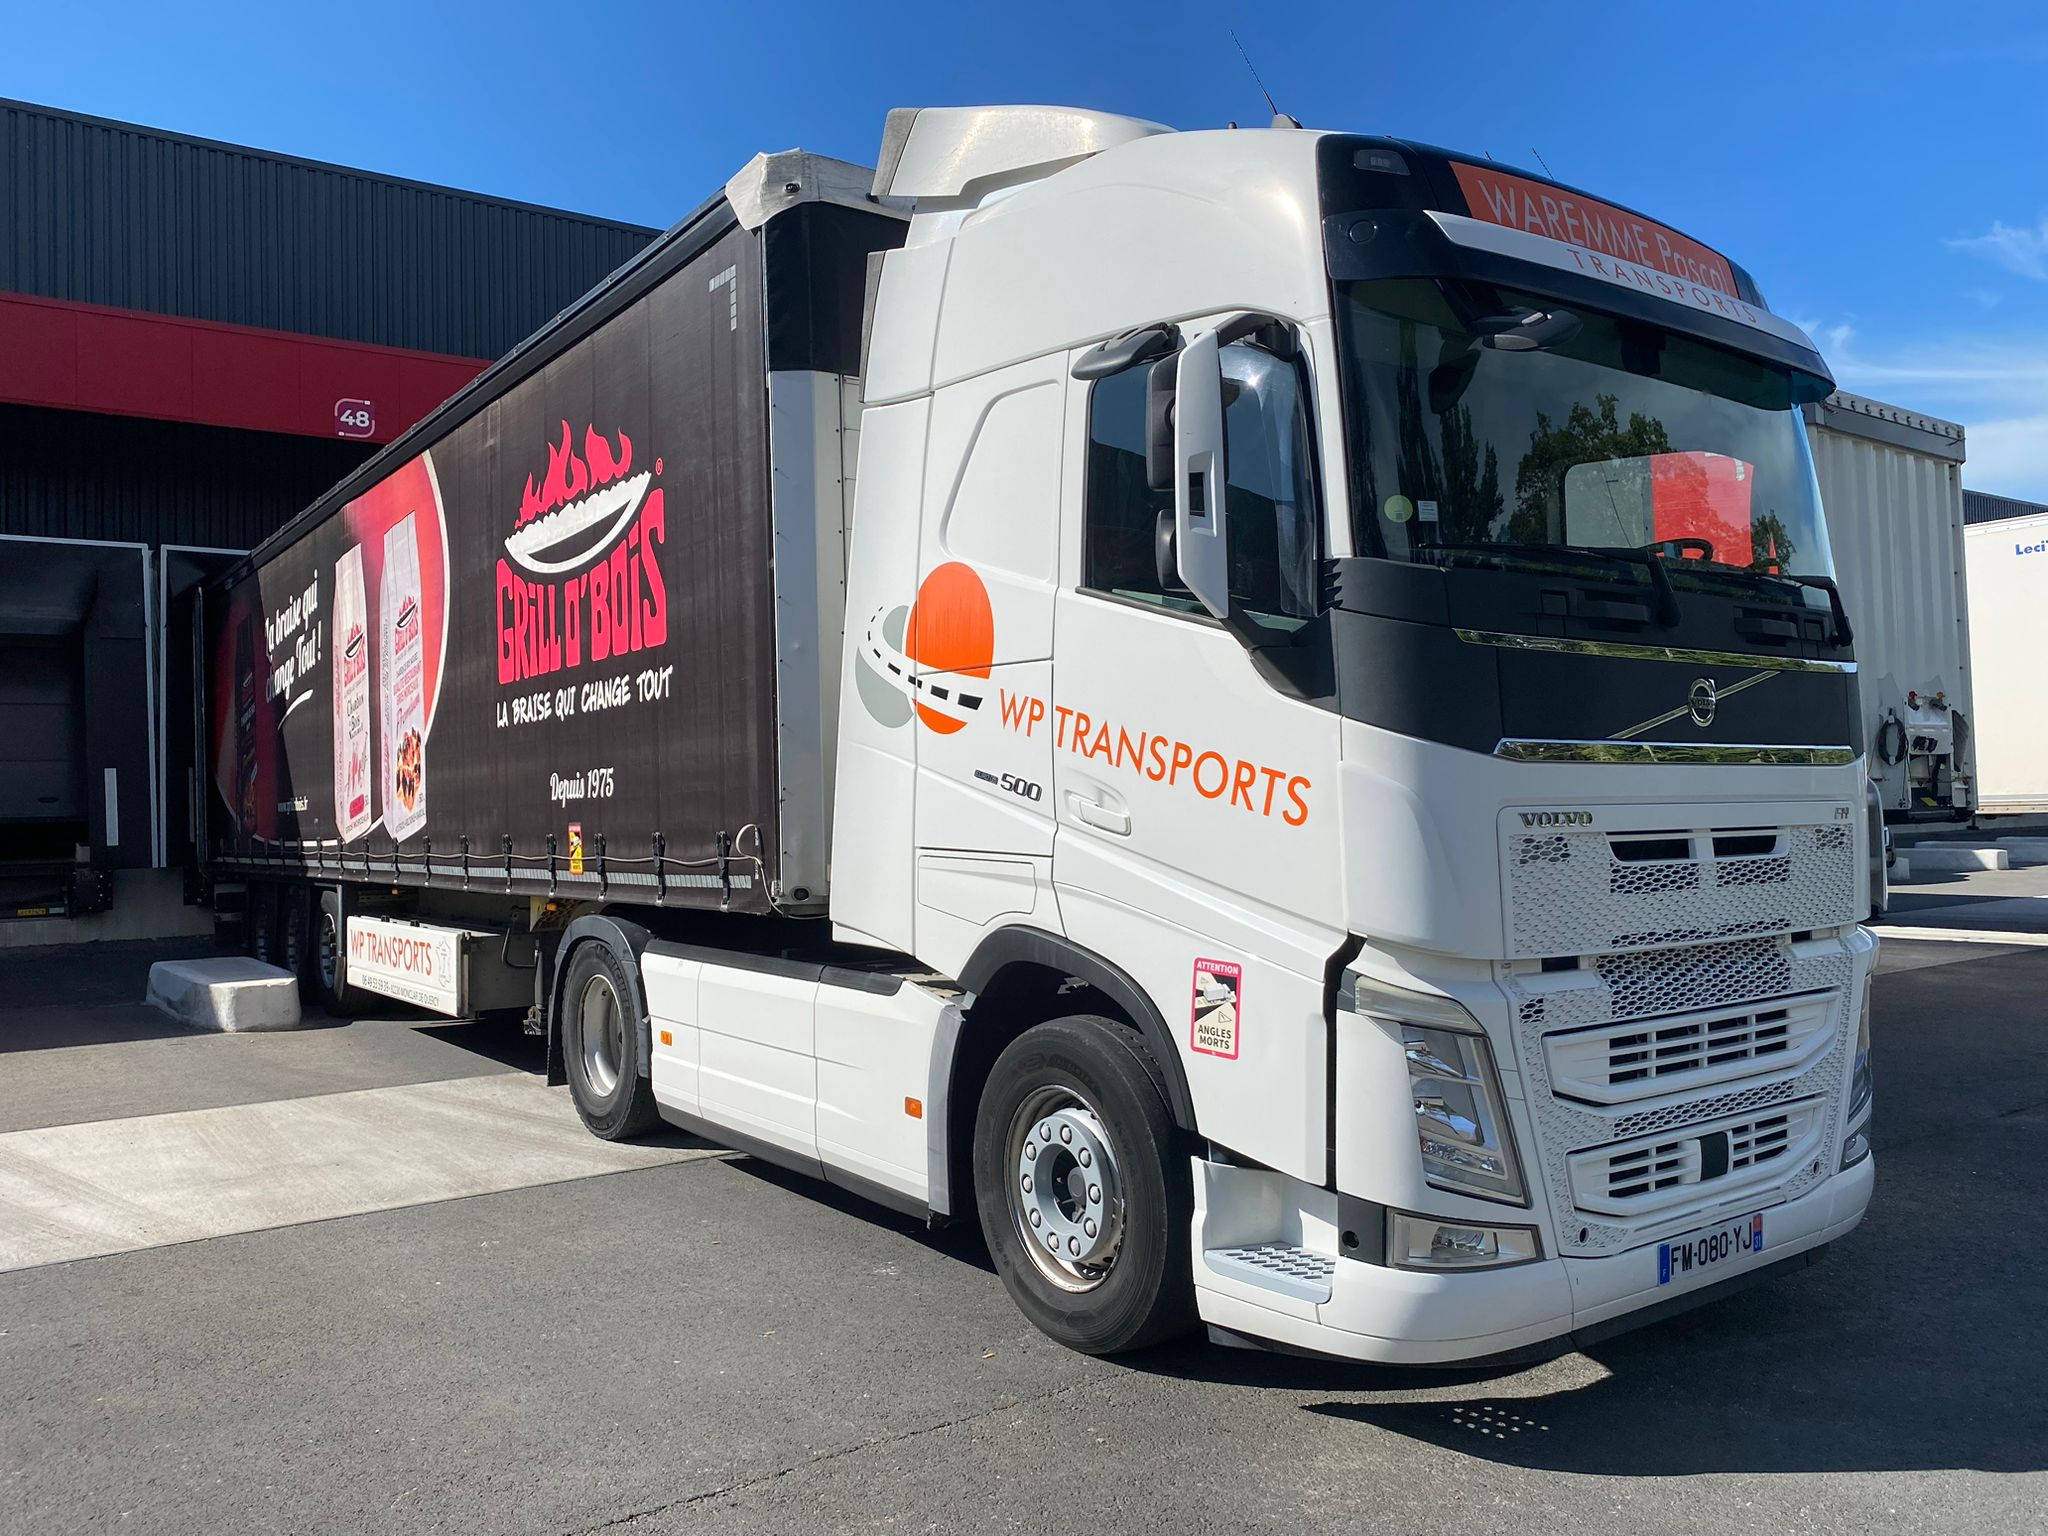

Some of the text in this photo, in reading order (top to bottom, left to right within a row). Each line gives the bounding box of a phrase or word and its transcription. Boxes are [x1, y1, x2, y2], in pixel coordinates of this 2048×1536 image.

[1478, 179, 1731, 297] WAREMME Pascal
[1567, 248, 1757, 324] TRANSPORTS
[340, 409, 370, 427] 48
[2015, 539, 2048, 556] Leci
[302, 568, 318, 631] qui
[496, 664, 674, 728] LA BRAISE QUI CHANGE TOUT
[999, 687, 1312, 827] WP TRANSPORTS
[550, 767, 614, 808] Depuis 1975
[1000, 773, 1043, 802] 500
[1518, 811, 1593, 828] VOLVO
[350, 929, 365, 960] WP
[366, 931, 432, 976] TRANSPORTS
[1196, 961, 1239, 975] ATTENTION
[1198, 1024, 1232, 1039] ANGLES
[1199, 1035, 1230, 1049] MORTS
[1671, 1222, 1752, 1276] FM-080-YJ
